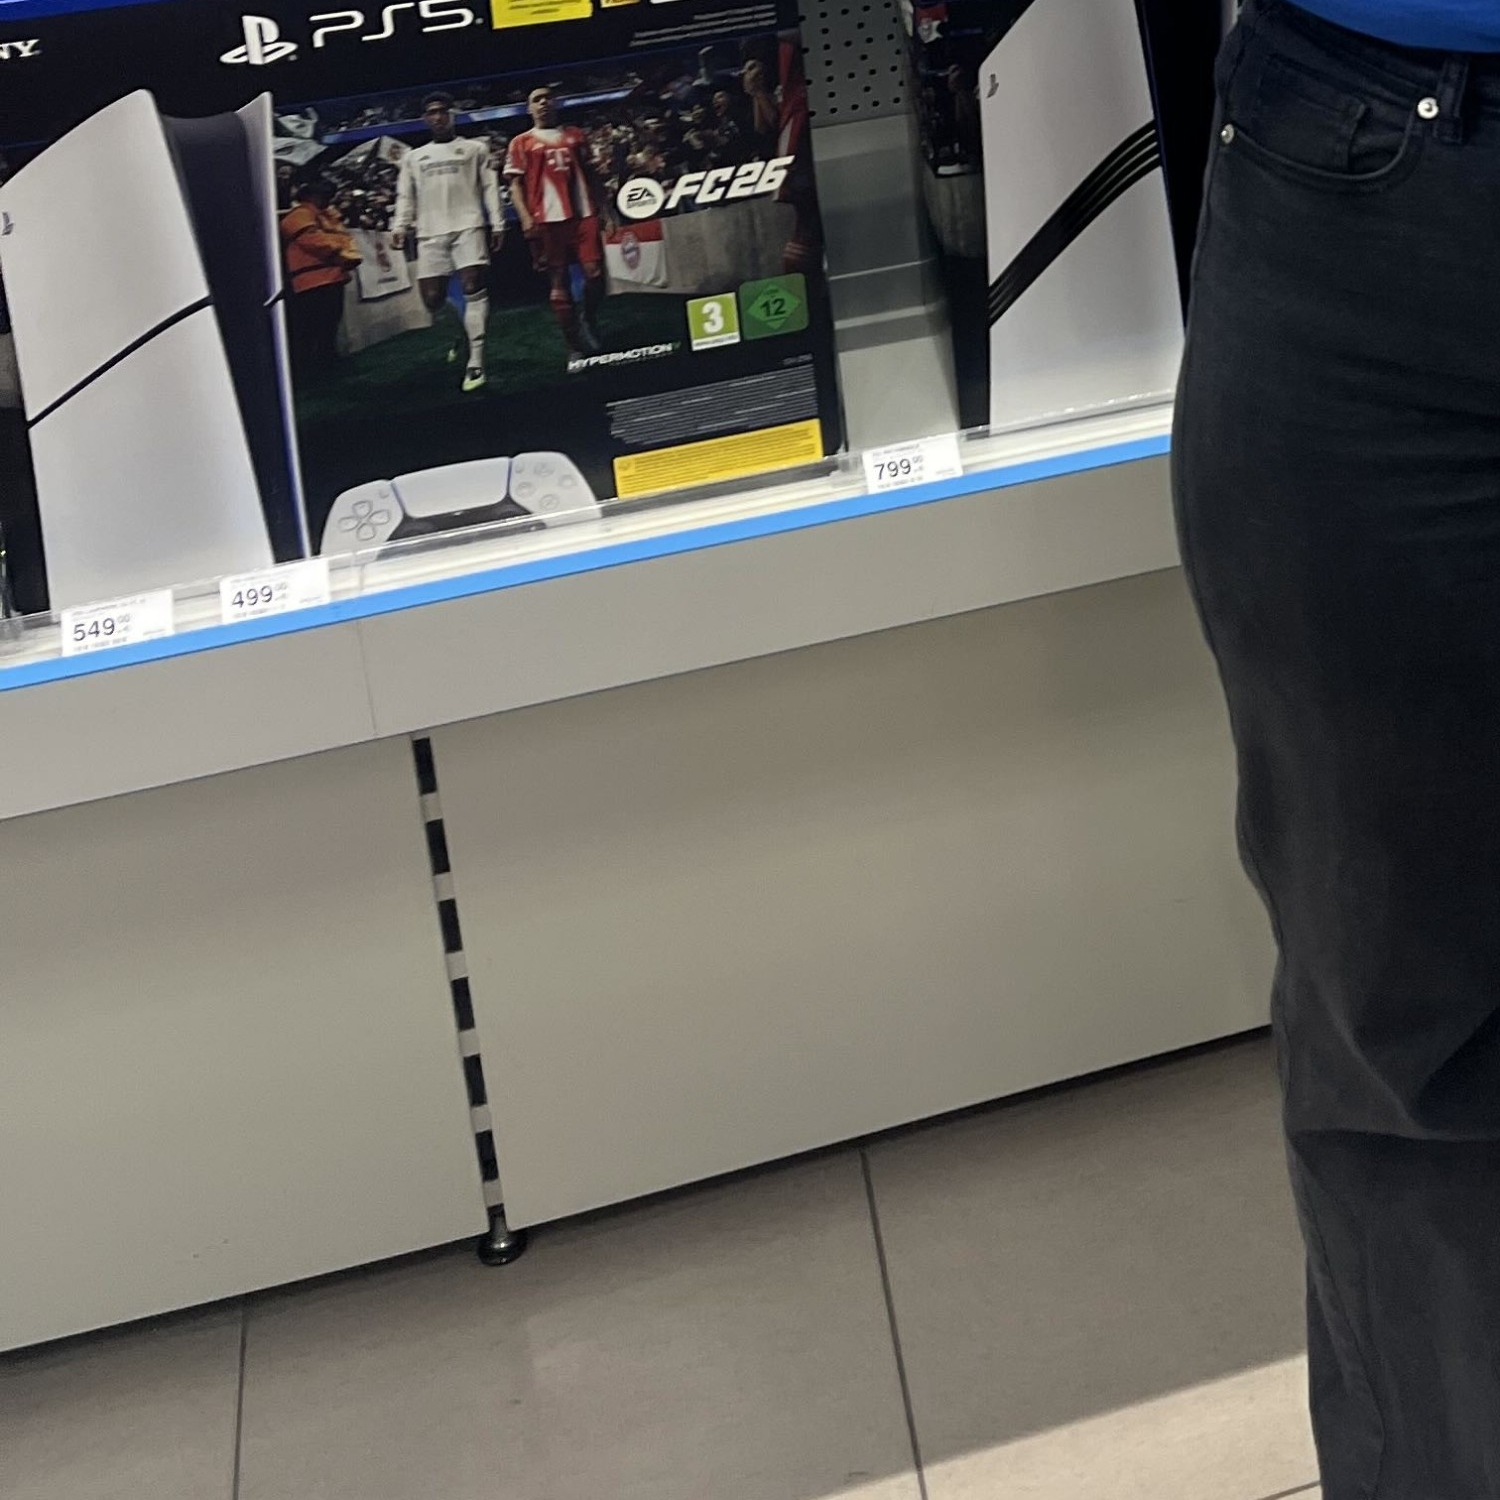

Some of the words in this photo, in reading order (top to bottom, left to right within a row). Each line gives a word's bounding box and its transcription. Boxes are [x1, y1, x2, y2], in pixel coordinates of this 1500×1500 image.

[664, 155, 796, 209] FC26
[702, 301, 725, 334] 3
[760, 298, 786, 317] 12
[874, 458, 911, 480] 799
[232, 586, 272, 608] 499
[73, 617, 115, 642] 549
